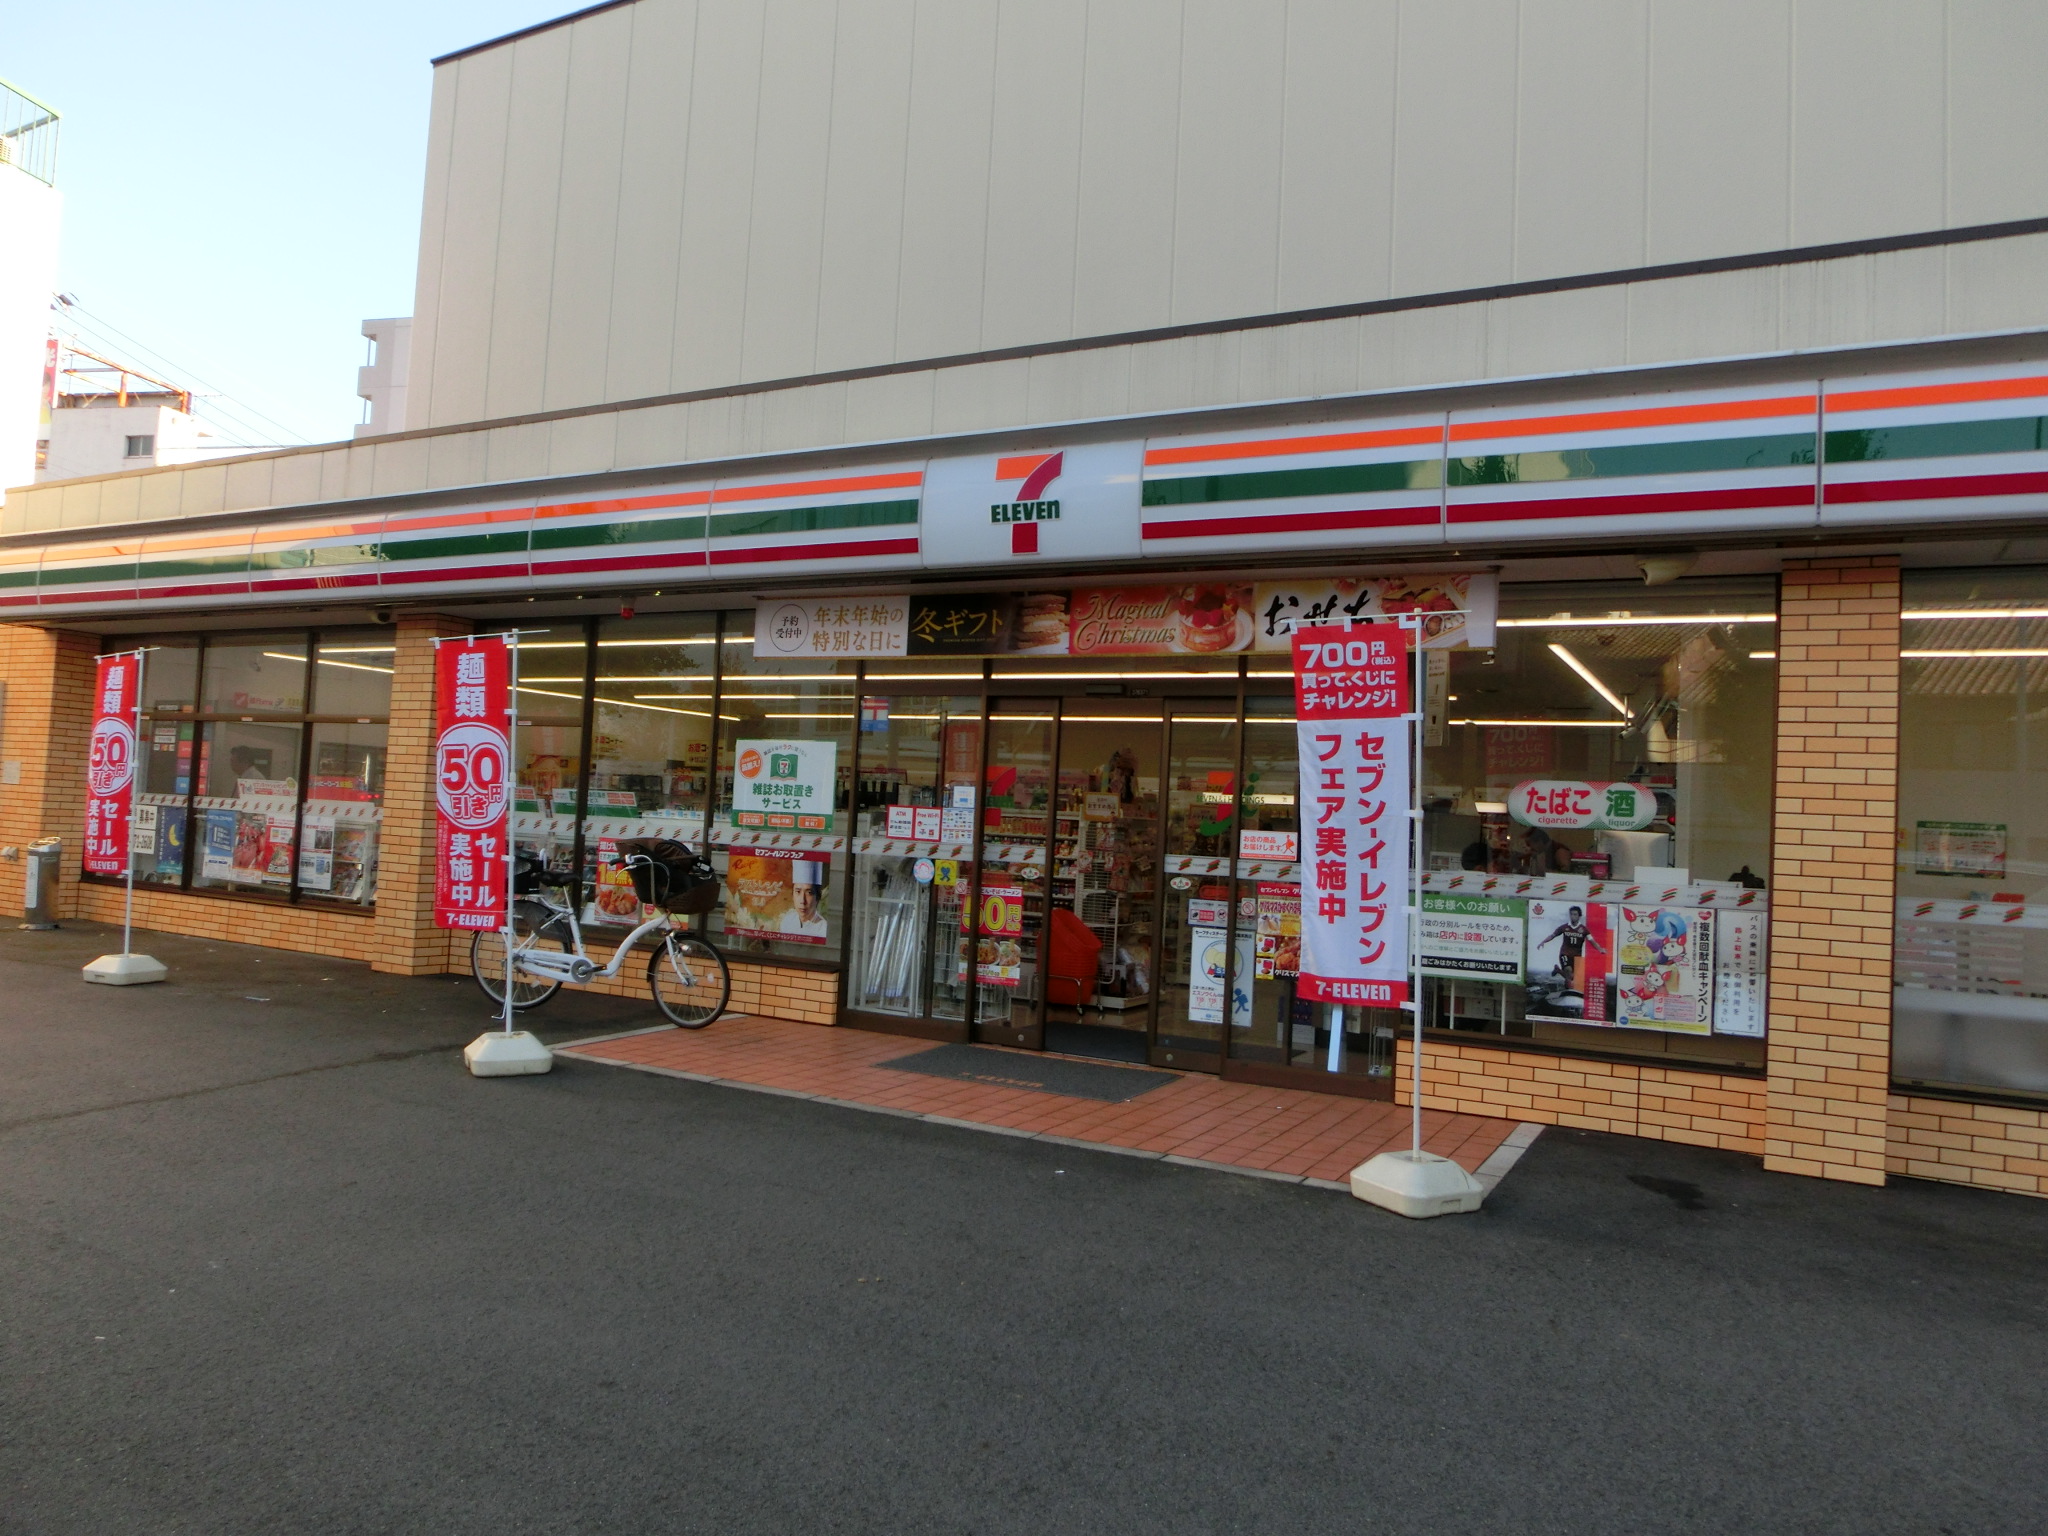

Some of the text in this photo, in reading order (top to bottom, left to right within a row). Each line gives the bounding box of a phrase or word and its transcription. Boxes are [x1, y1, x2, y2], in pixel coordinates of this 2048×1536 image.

[813, 605, 904, 627] 年末年始の
[1075, 593, 1174, 624] Magical
[781, 616, 799, 627] 予約
[910, 607, 1005, 643] 冬ギフト
[775, 628, 802, 639] 受付中
[811, 630, 902, 651] 特別な日に
[1074, 621, 1177, 651] Christmas
[455, 653, 486, 718] 麺類
[1301, 670, 1396, 689] 買って、くじに
[752, 782, 814, 798] 雑誌お取置き
[762, 798, 801, 809] サービス
[1525, 786, 1592, 816] たばこ
[1605, 788, 1637, 818] 酒
[100, 799, 119, 856] セール
[1314, 734, 1348, 925] フェア実施中
[1537, 815, 1579, 826] cigarette
[1608, 819, 1636, 828] liquor
[1243, 836, 1277, 844] お店の商品
[449, 833, 473, 907] 実施中
[475, 833, 497, 907] セール
[1423, 898, 1510, 913] お客様へのお願い
[1569, 936, 1578, 945] 11
